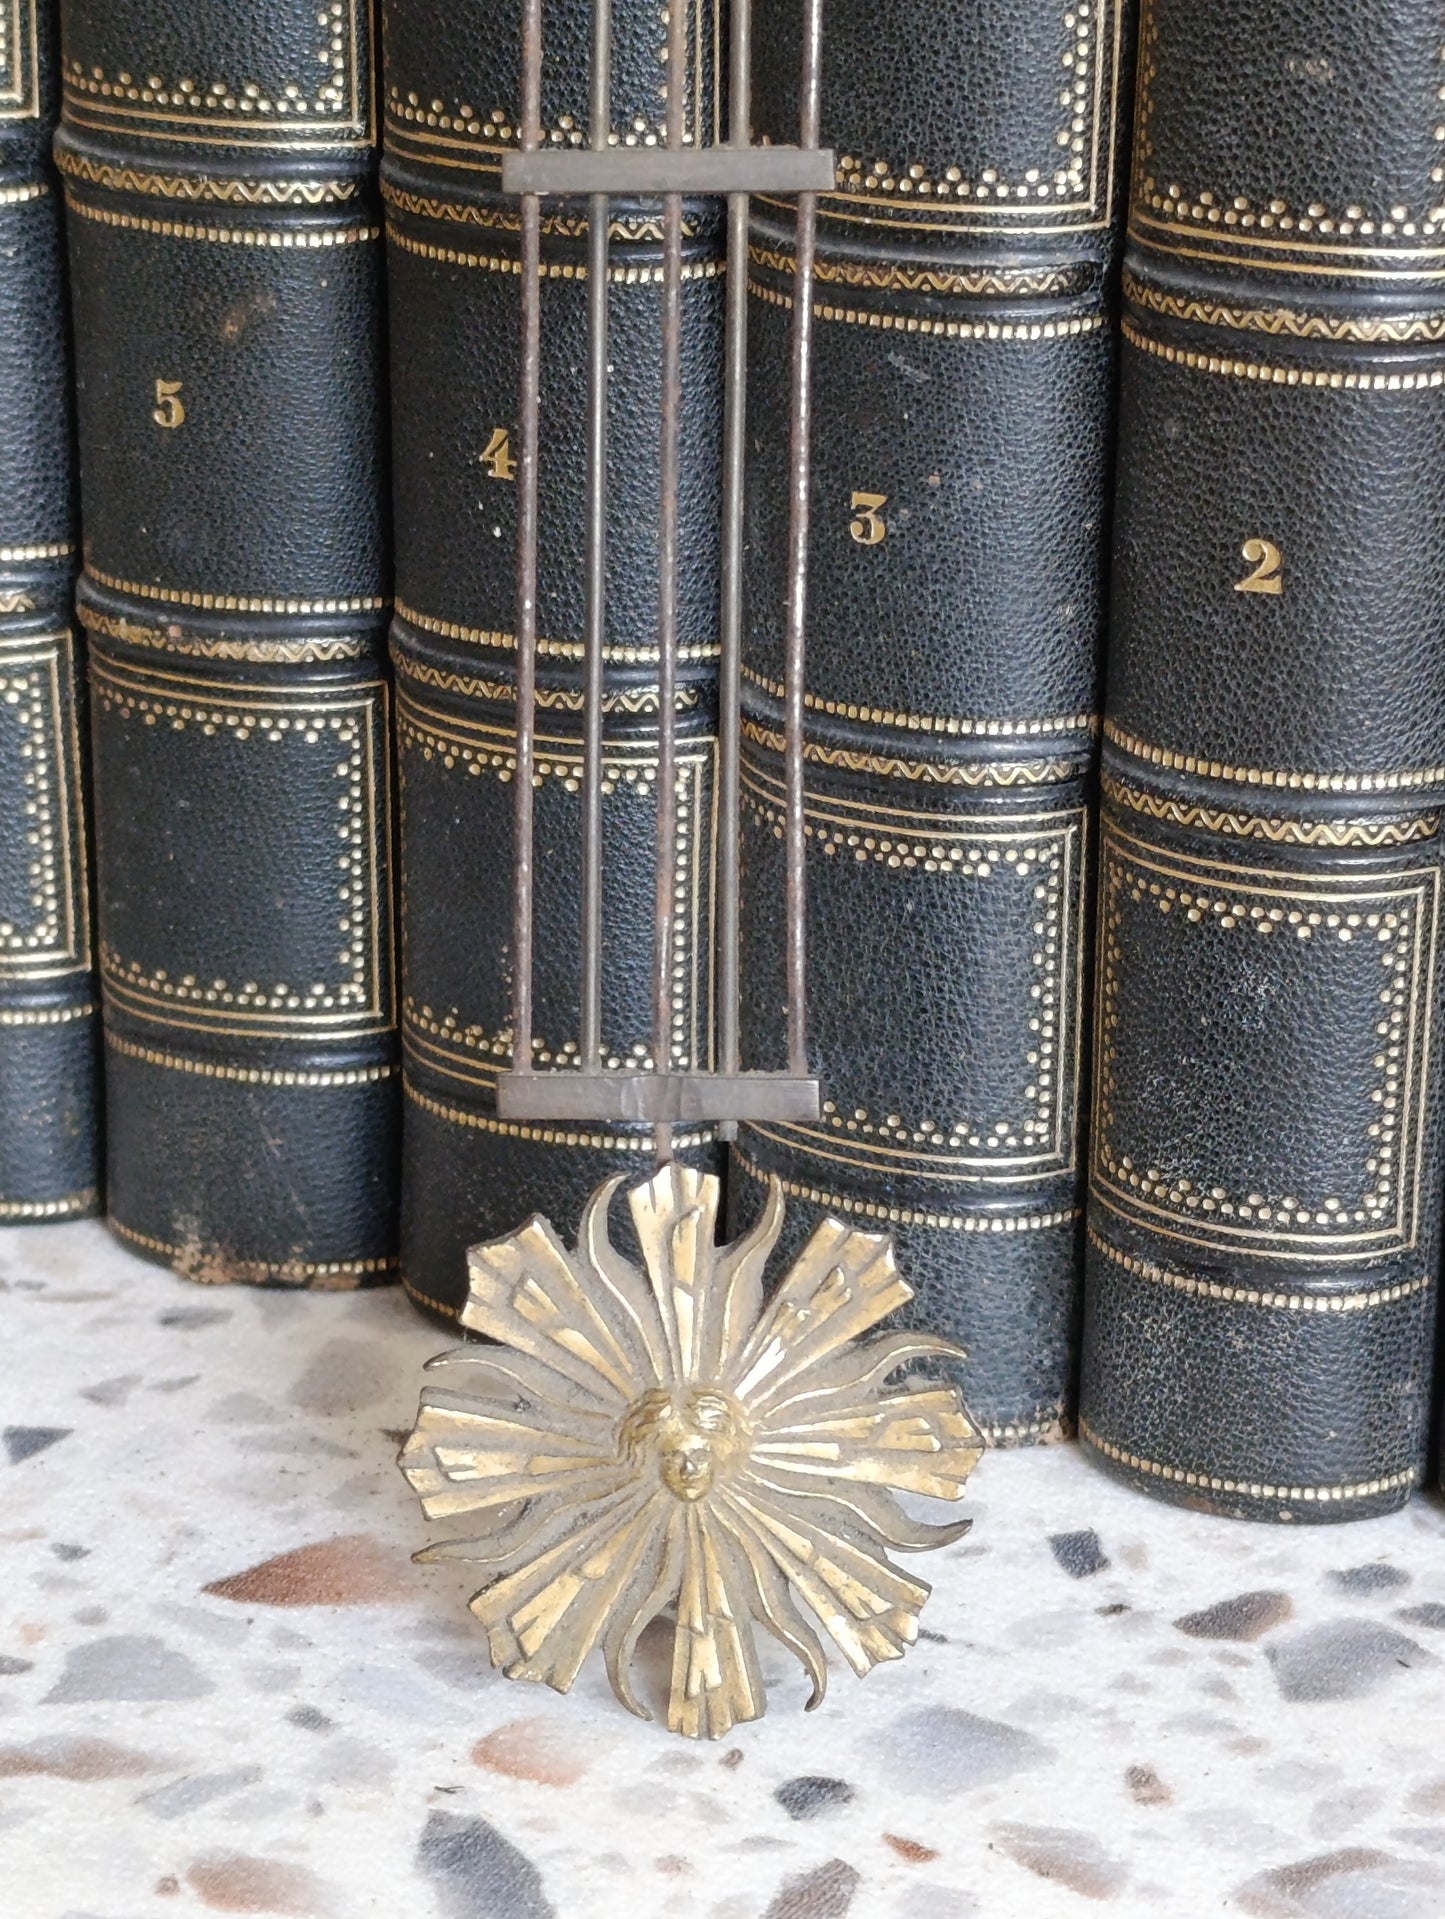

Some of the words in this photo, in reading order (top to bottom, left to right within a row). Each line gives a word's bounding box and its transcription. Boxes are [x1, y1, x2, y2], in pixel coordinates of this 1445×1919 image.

[152, 380, 186, 429] 5
[479, 427, 518, 481] 4
[849, 491, 888, 545] 3
[1233, 538, 1284, 595] 2
